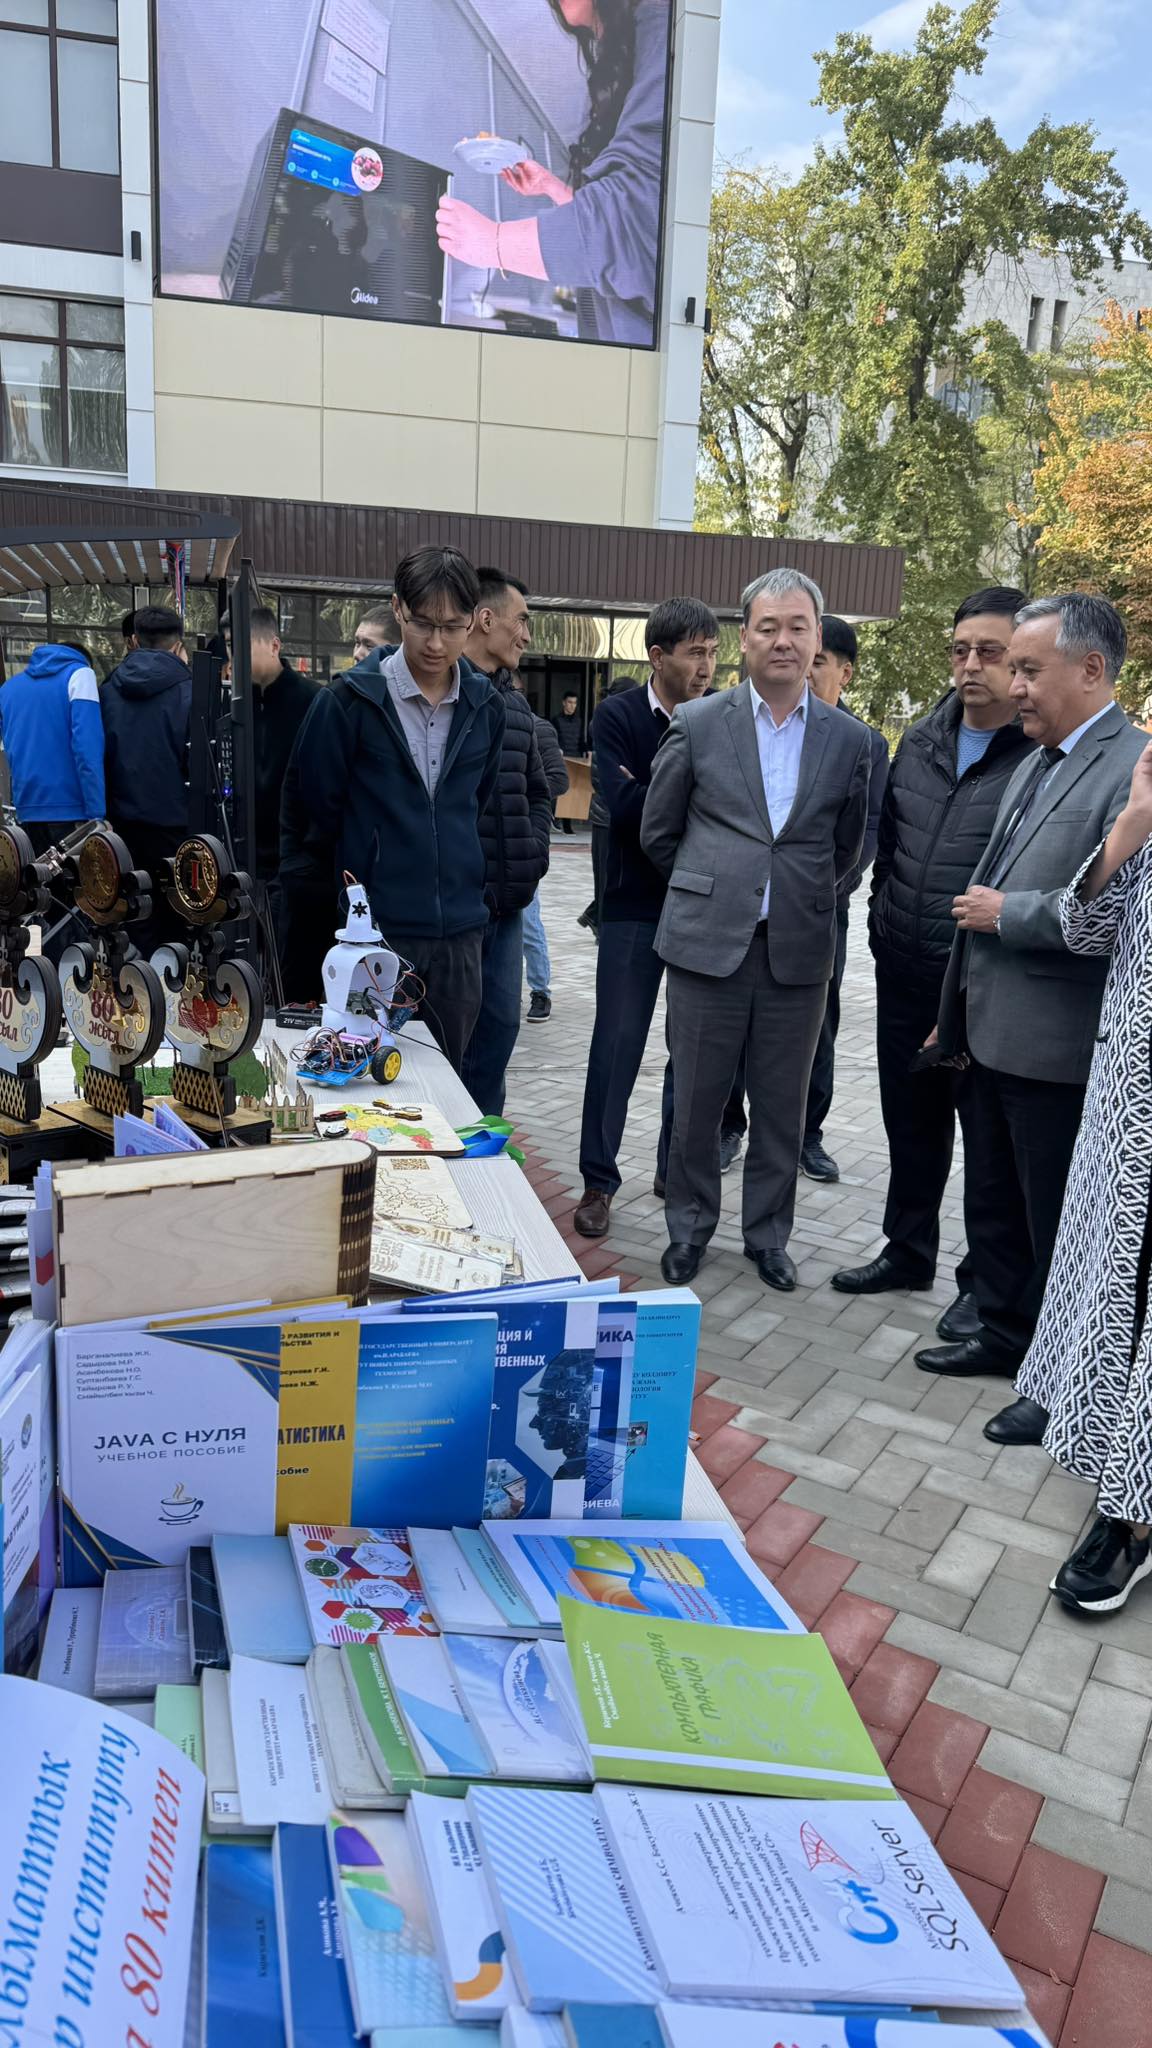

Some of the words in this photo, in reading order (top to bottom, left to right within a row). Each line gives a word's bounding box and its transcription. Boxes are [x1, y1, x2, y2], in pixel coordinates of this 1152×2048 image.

[91, 990, 115, 1022] 80
[597, 1330, 634, 1343] ИКА
[94, 1433, 155, 1450] JAVA
[162, 1431, 177, 1445] С
[185, 1427, 246, 1443] НУЛЯ
[97, 1450, 168, 1463] УЧЕБНОЕ
[174, 1445, 246, 1459] ПОСОБИЕ
[646, 1631, 702, 1744] КОМПЬЮТЕРНАЯ
[680, 1656, 722, 1720] ГРАФИКА
[61, 1722, 141, 2009] институту
[874, 1820, 935, 1895] Server
[119, 1932, 163, 2017] 80
[142, 1766, 182, 1936] китеп
[920, 1900, 969, 1951] SQL
